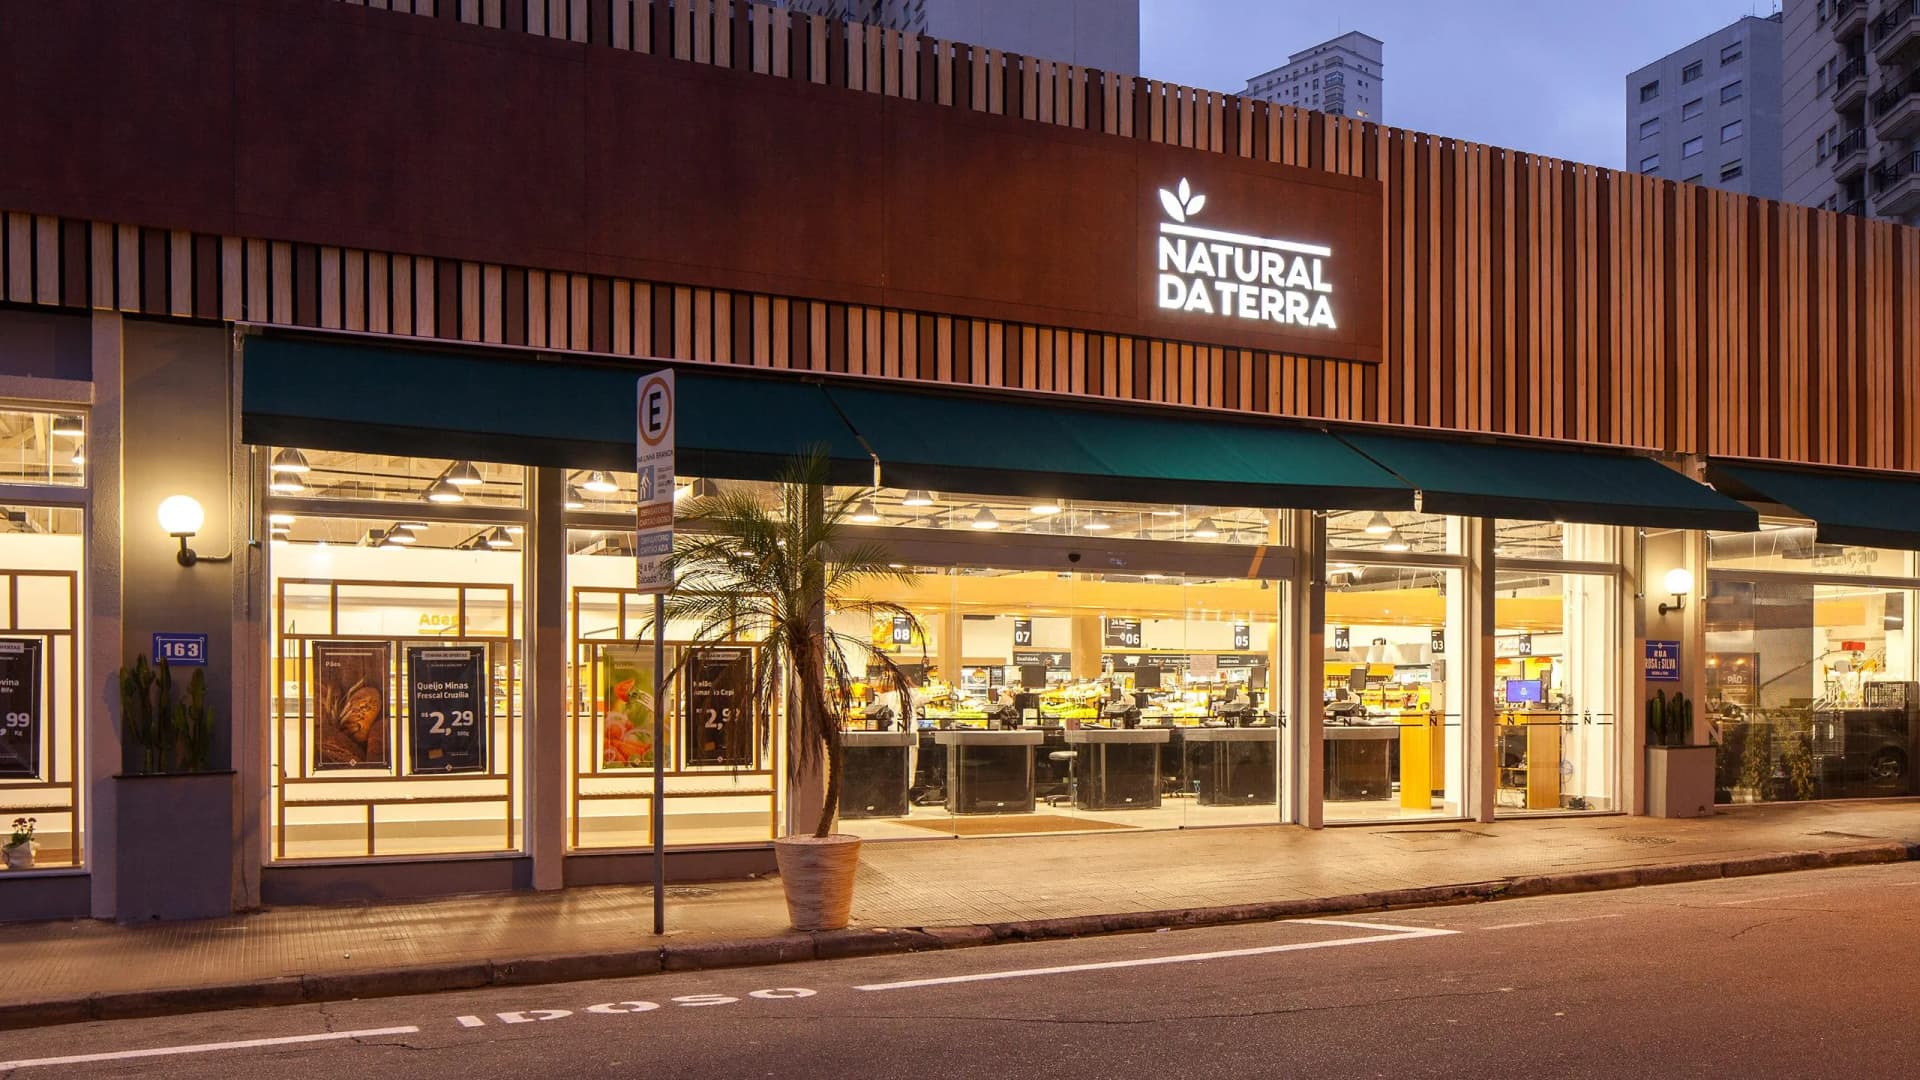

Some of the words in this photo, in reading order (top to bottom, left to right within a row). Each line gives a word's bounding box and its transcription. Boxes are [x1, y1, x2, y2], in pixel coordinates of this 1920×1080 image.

[1159, 236, 1332, 293] NATURAL
[1159, 273, 1214, 314] DA
[1214, 281, 1337, 329] TERRA
[649, 391, 661, 432] E
[893, 629, 910, 641] 08
[1015, 631, 1030, 643] 07
[1126, 633, 1140, 644] 06
[1235, 635, 1249, 647] 05
[1335, 637, 1349, 649] 04
[1432, 639, 1444, 650] 03
[1520, 641, 1531, 652] 02
[163, 643, 199, 657] 163
[1653, 650, 1668, 658] RUA
[1661, 658, 1676, 670] SILVA
[417, 682, 443, 691] Queijo
[445, 682, 469, 690] Minas
[429, 710, 474, 736] 2,29
[456, 987, 818, 1028] IDOSO
